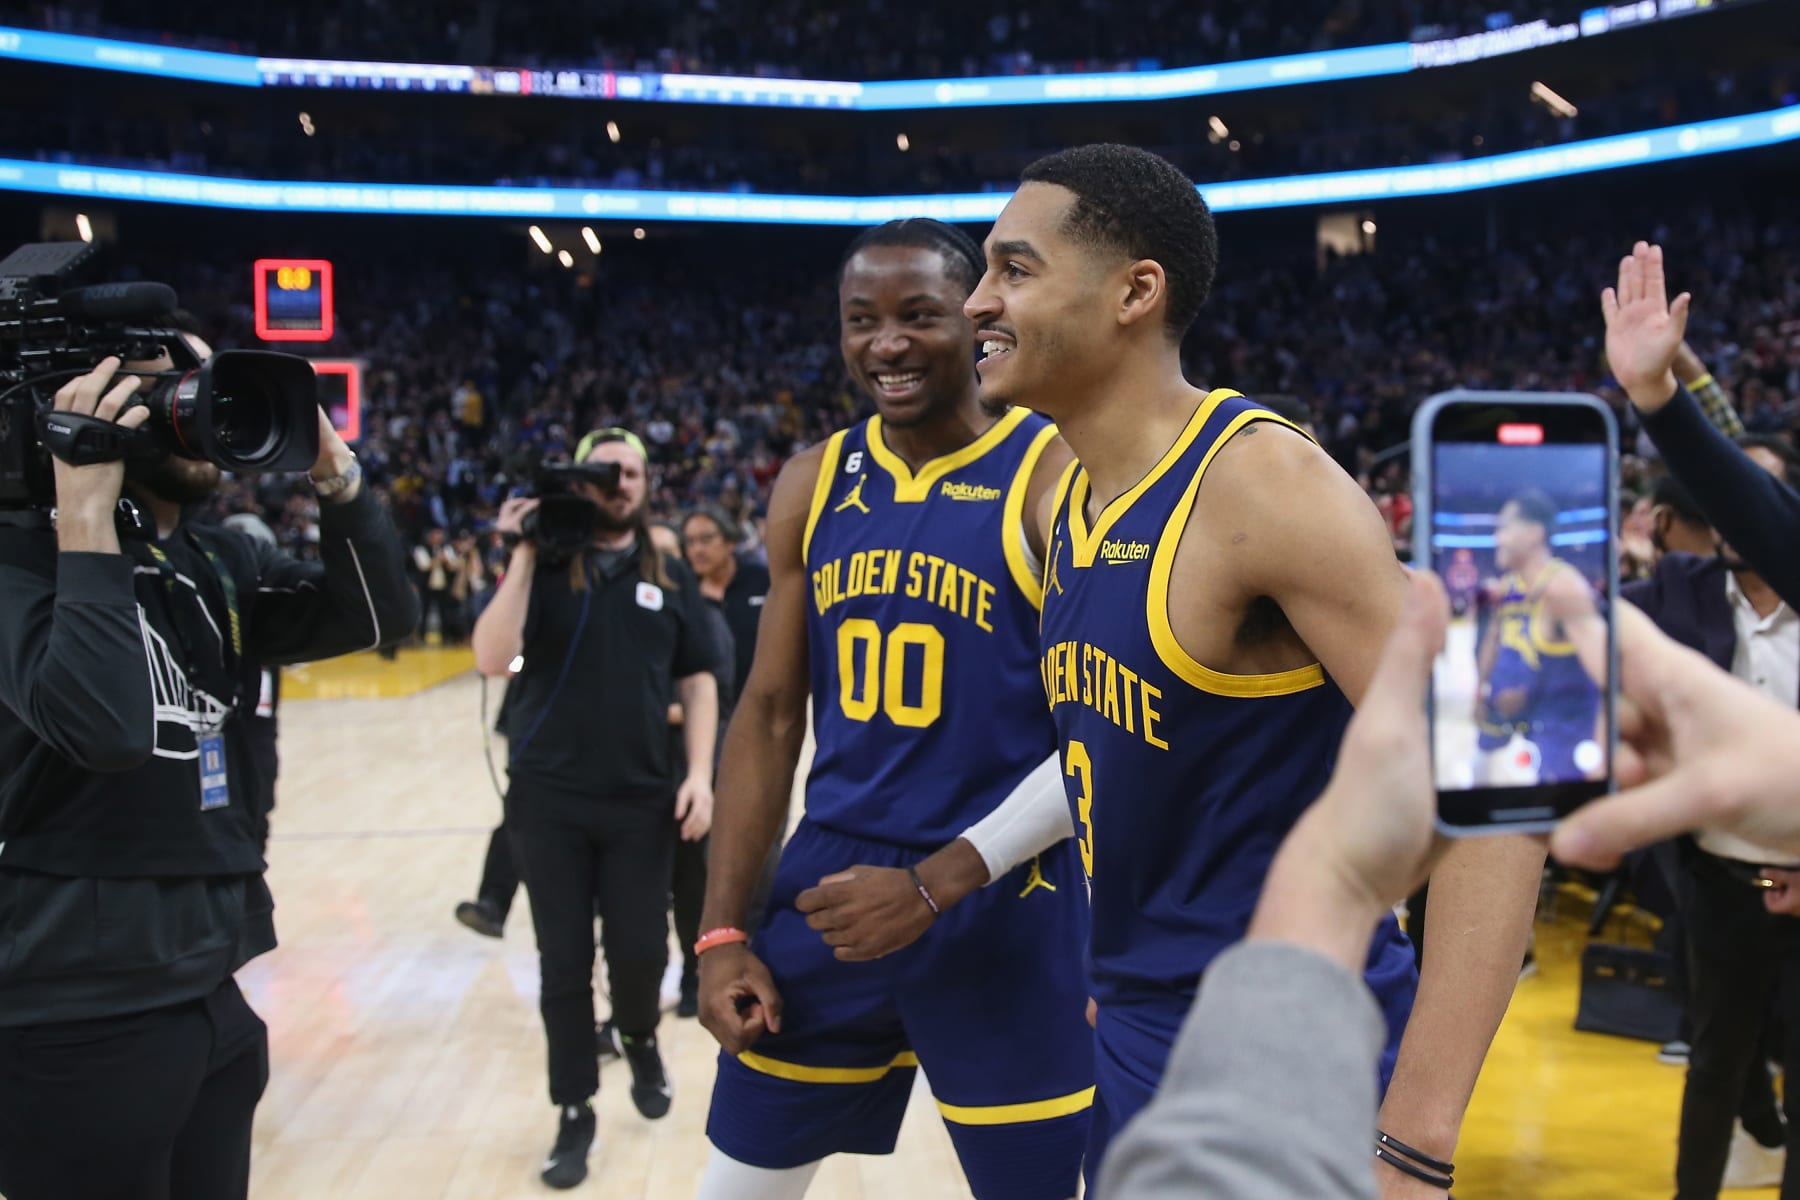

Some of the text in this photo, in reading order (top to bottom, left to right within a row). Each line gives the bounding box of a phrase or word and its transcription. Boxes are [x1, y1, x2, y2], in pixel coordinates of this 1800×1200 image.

[845, 451, 863, 473] 6
[941, 481, 1001, 500] Rakuten
[1100, 538, 1150, 560] Rakuten
[812, 549, 997, 633] GOLDEN STATE
[836, 618, 945, 728] 00
[1082, 642, 1169, 751] STATE
